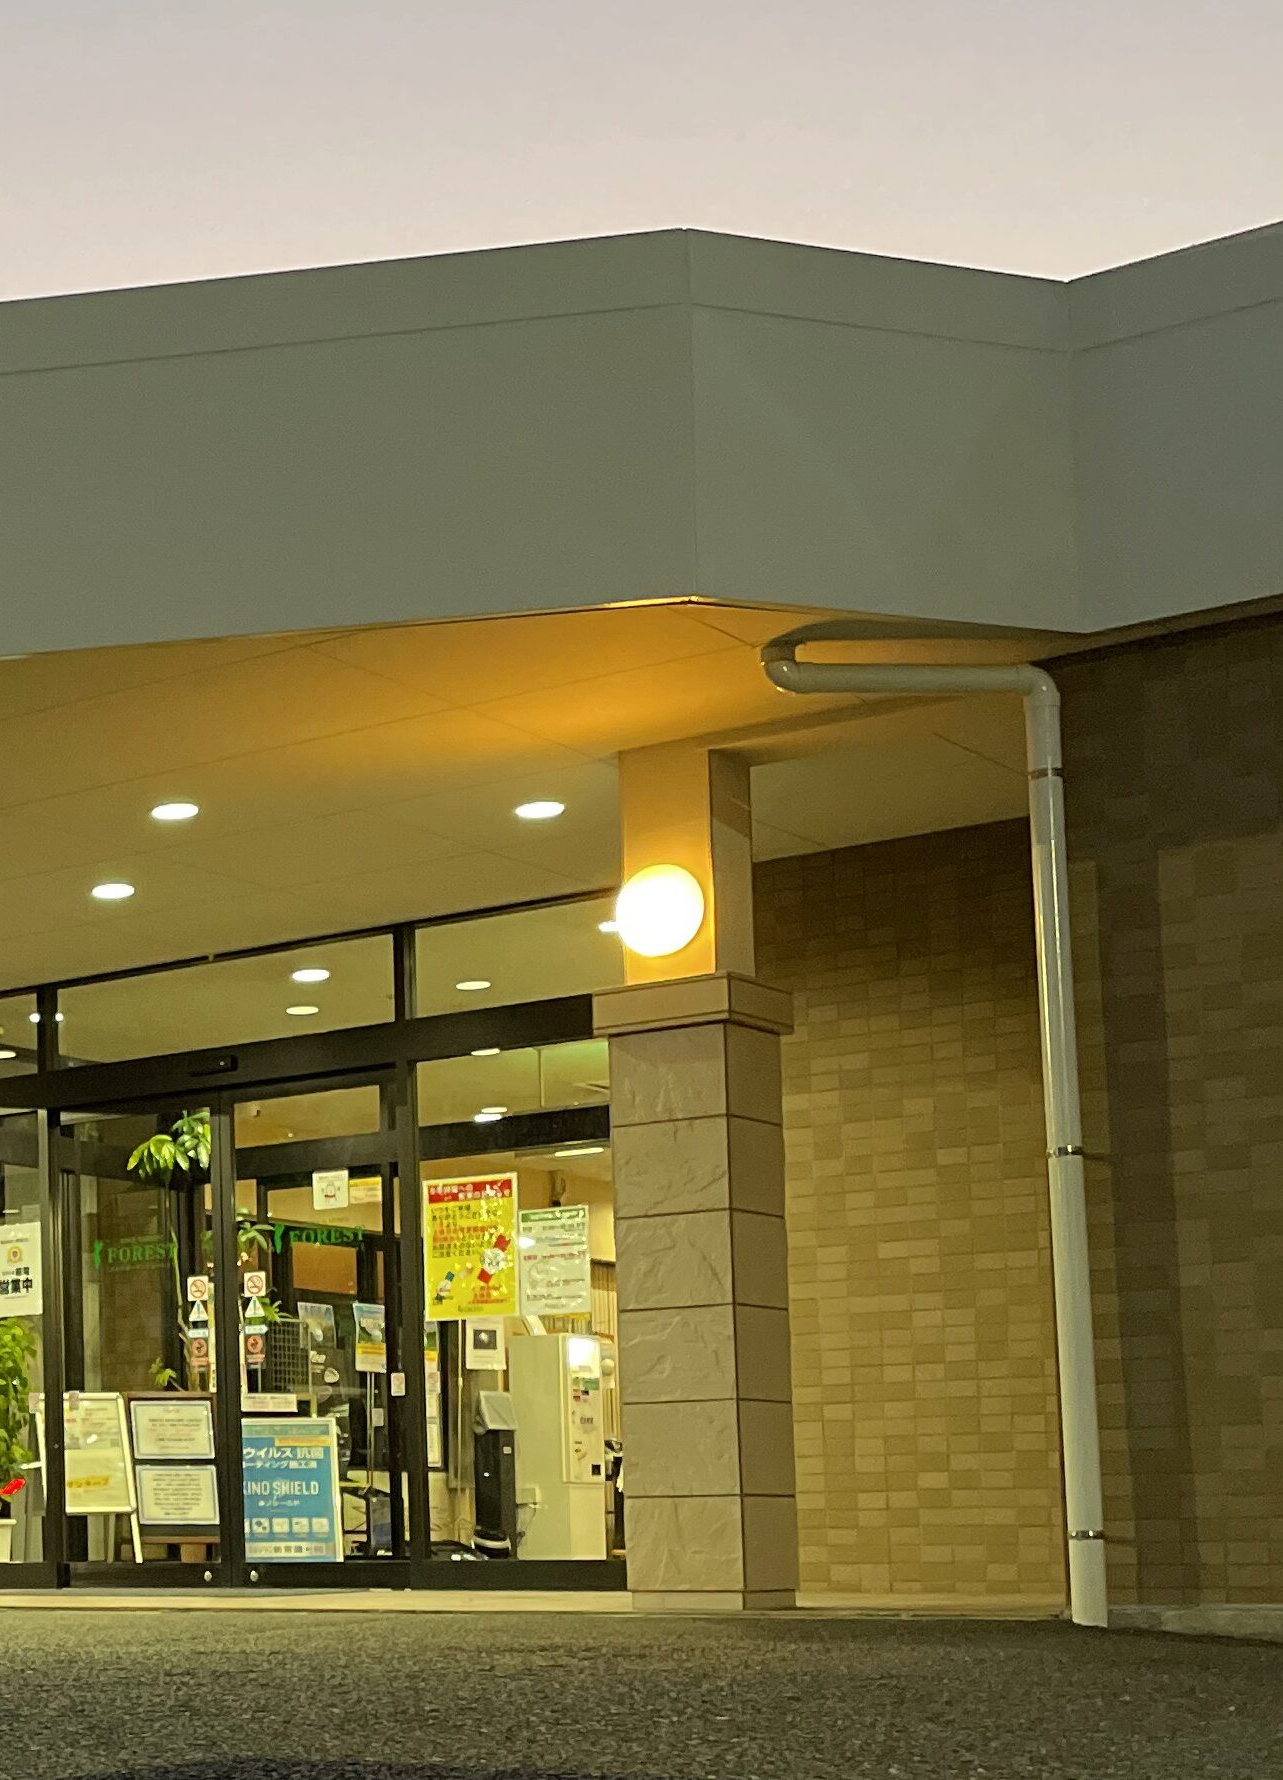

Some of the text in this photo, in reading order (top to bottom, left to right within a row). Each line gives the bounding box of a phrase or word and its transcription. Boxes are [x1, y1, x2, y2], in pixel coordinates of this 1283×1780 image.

[290, 1225, 365, 1244] FOREST
[107, 1241, 176, 1264] FOREST
[273, 1480, 319, 1496] SHIELD
